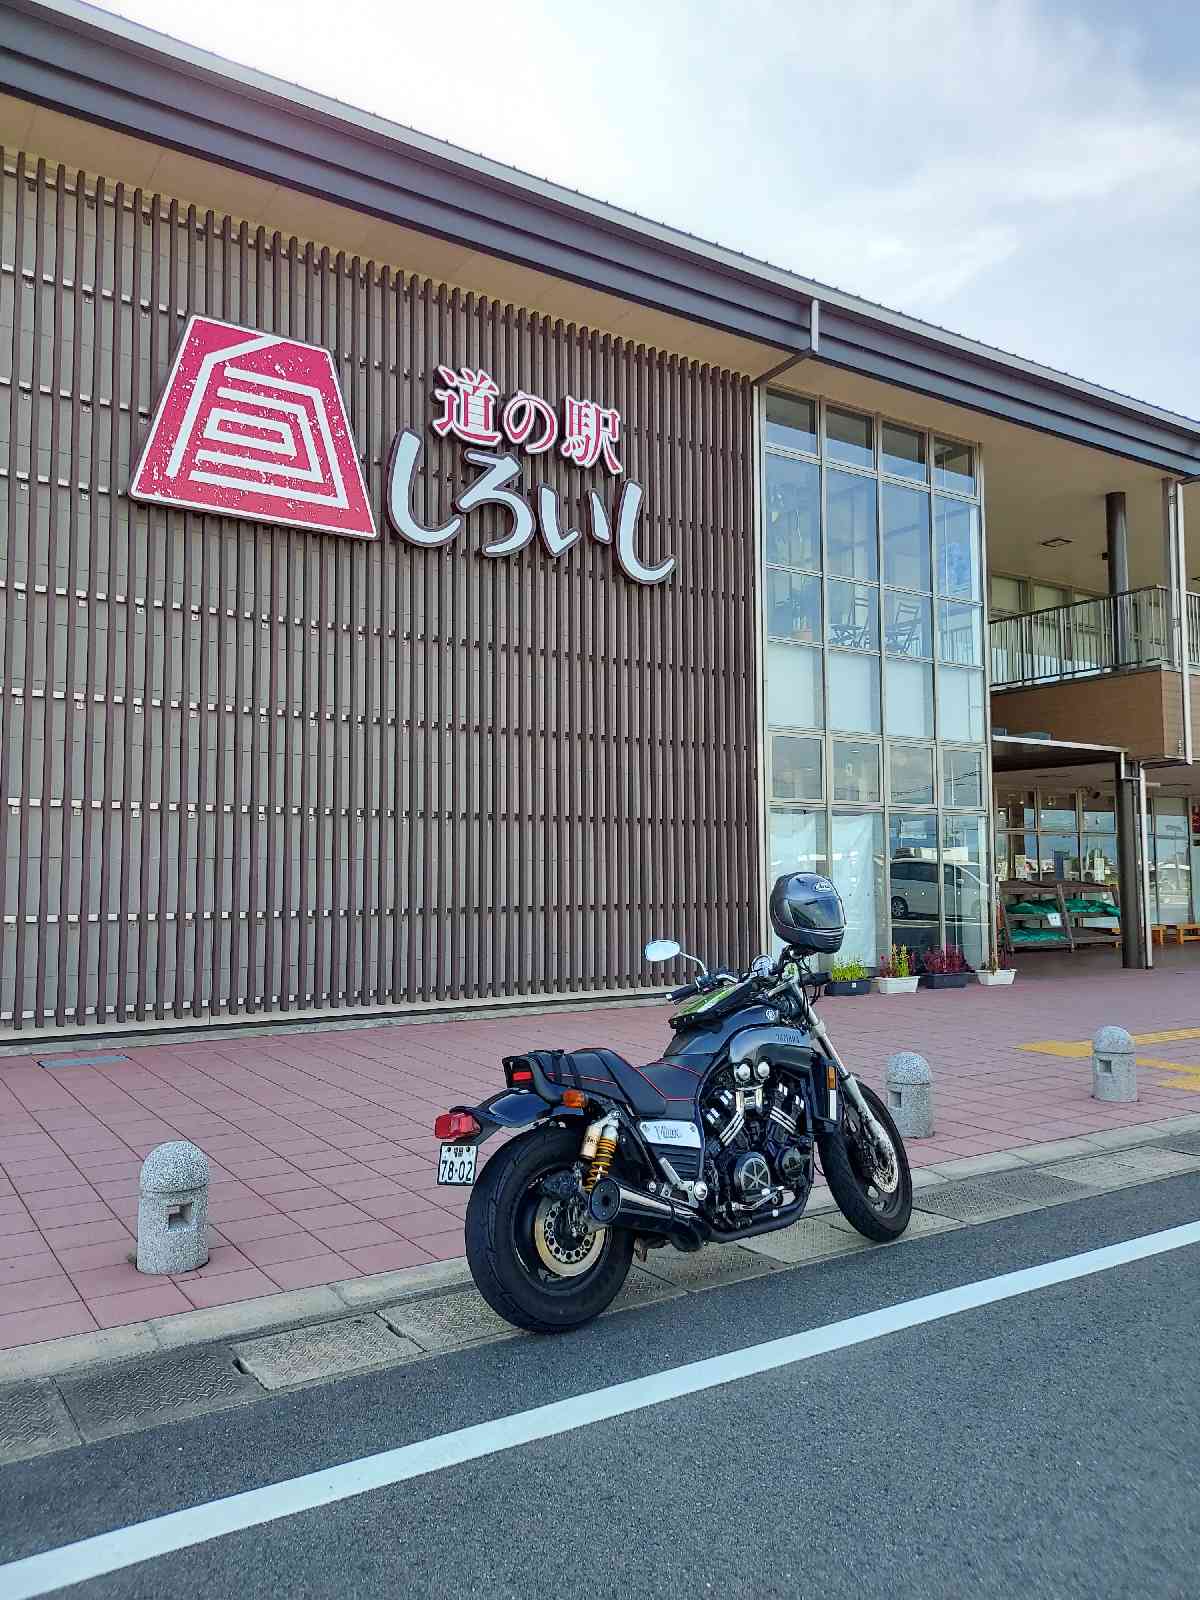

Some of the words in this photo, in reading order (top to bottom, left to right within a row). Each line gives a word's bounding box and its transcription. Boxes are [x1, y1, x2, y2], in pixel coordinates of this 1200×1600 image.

[432, 365, 623, 474] 道の駅
[388, 428, 676, 584] しろいし
